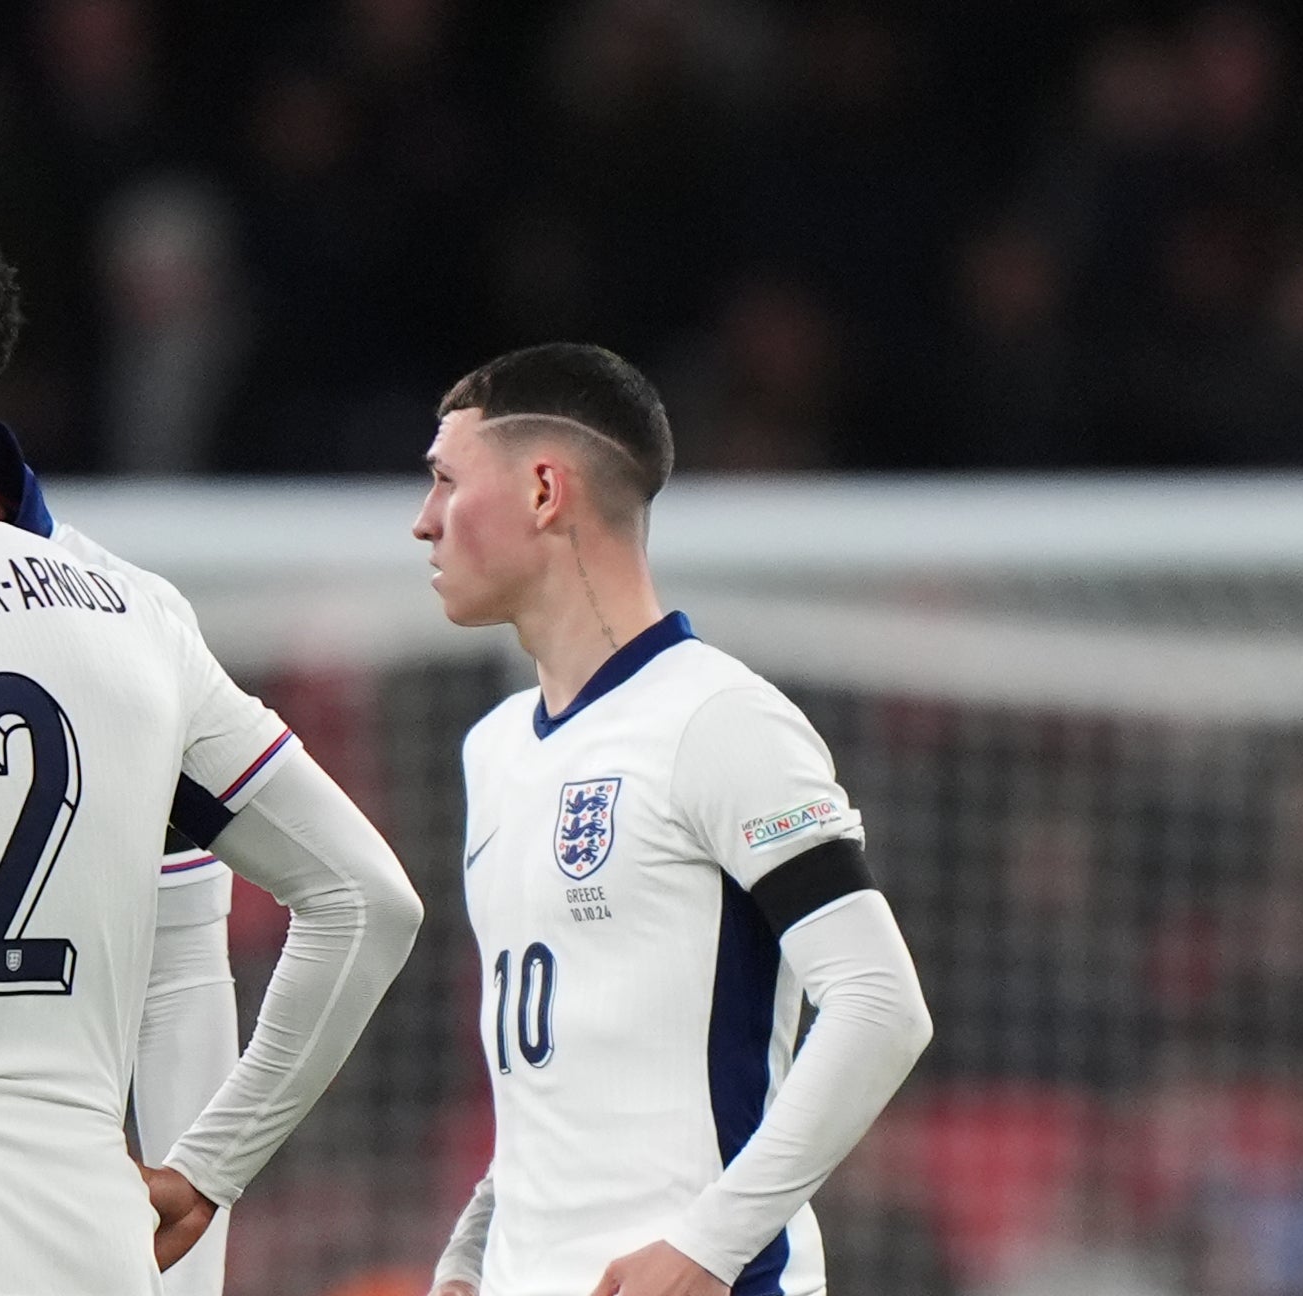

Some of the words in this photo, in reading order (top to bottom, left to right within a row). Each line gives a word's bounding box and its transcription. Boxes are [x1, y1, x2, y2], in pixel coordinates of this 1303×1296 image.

[744, 801, 838, 845] FOUNDATION
[566, 886, 606, 904] GREECE
[570, 905, 612, 922] 10.10.24
[494, 941, 558, 1075] 10
